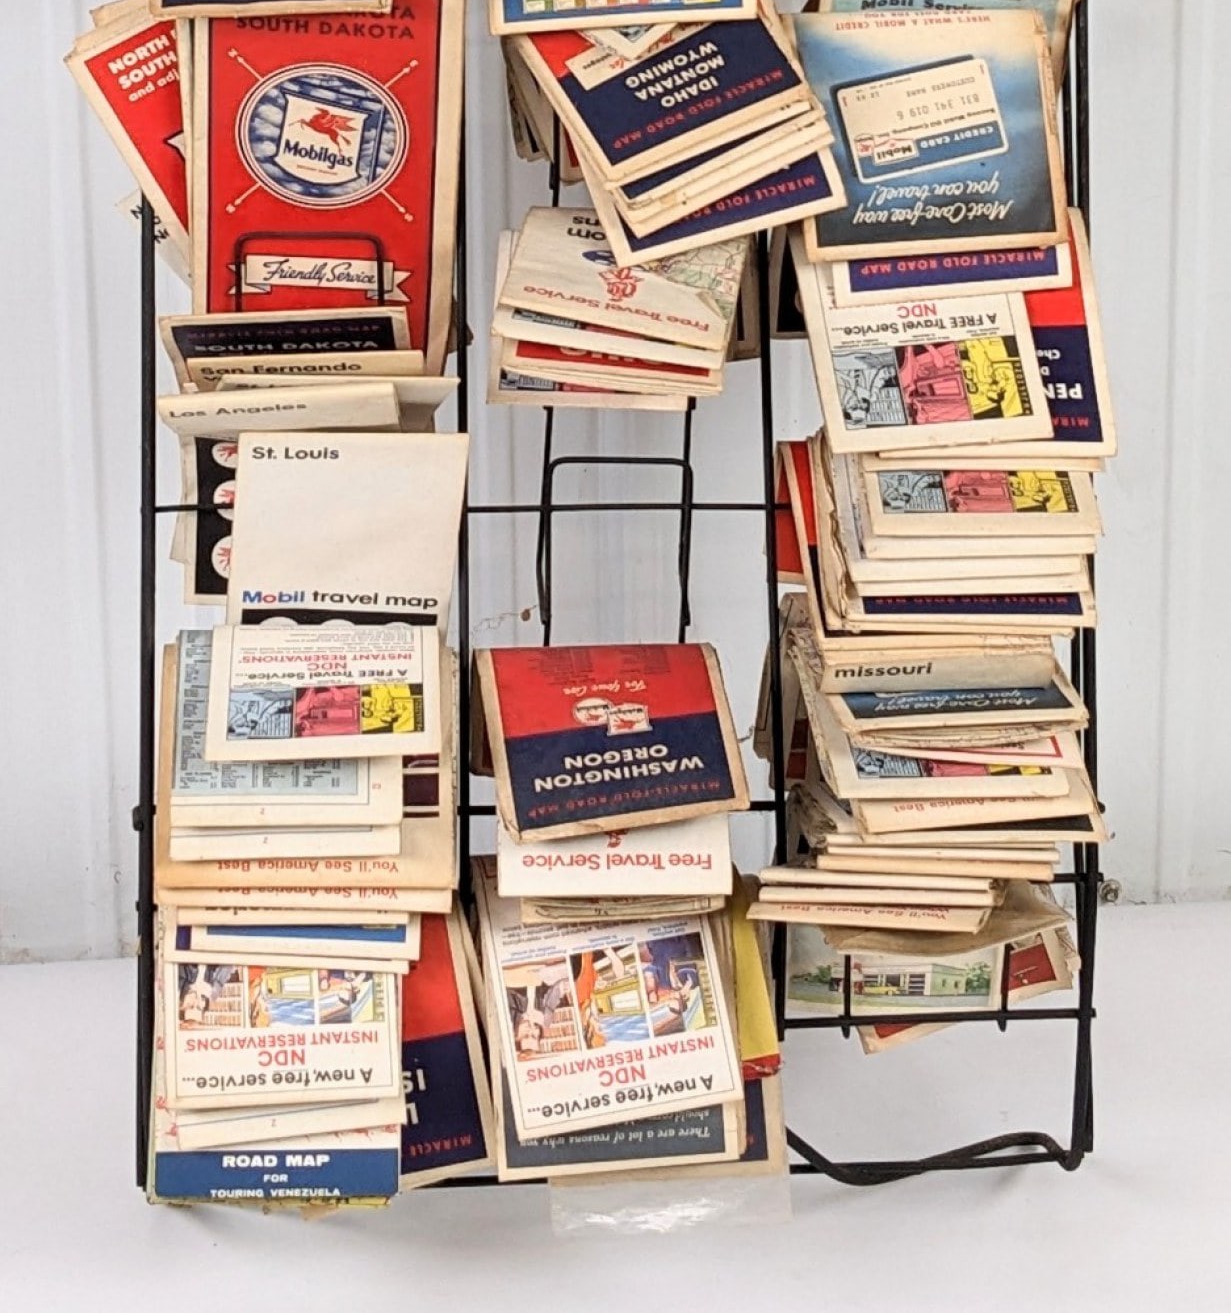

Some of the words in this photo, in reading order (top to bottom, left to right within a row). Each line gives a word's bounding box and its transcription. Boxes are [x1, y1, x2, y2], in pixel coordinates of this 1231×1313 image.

[236, 16, 309, 34] SOUTH
[319, 20, 415, 40] DAKOTA
[108, 35, 170, 74] NORTH
[118, 51, 178, 90] SOUTH
[625, 42, 718, 88] WYOMING
[635, 55, 725, 102] MONTANA
[129, 84, 155, 103] and
[661, 76, 719, 108] IDAHO
[920, 134, 950, 148] CARD
[952, 126, 994, 143] CREDIT
[283, 139, 353, 170] Mobilgas
[876, 146, 913, 161] Mobil
[932, 182, 965, 195] can
[968, 170, 1000, 195] you
[853, 204, 888, 225] way
[968, 199, 1014, 220] Most
[900, 259, 937, 271] ROAD
[944, 257, 978, 268] FOLD
[984, 252, 1045, 263] MIRACLE
[262, 261, 326, 286] Friendly
[326, 261, 377, 285] Service
[861, 263, 892, 276] MAP
[523, 286, 599, 309] Service
[605, 300, 661, 321] Travel
[898, 302, 938, 317] NDC
[667, 314, 710, 332] Free
[902, 315, 946, 332] Travel
[950, 313, 983, 328] FREE
[988, 312, 998, 324] A
[194, 343, 274, 351] SOUTH
[283, 339, 379, 351] DAKOTA
[200, 366, 245, 376] San
[253, 362, 362, 374] Fernando
[169, 409, 207, 418] Los
[216, 402, 307, 415] Angeles
[252, 446, 277, 460] St.
[284, 446, 339, 460] Louis
[242, 591, 305, 603] Mobil
[312, 591, 381, 606] travel
[386, 594, 438, 609] map
[835, 662, 932, 679] missouri
[564, 745, 668, 769] OREGON
[534, 755, 704, 792] WASHINGTON
[218, 860, 249, 872] Best
[258, 860, 318, 872] America
[326, 861, 352, 871] See
[360, 860, 399, 873] You'll
[522, 854, 600, 869] Service
[607, 854, 665, 869] Travel
[670, 854, 712, 869] Free
[311, 1031, 379, 1045] INSTANT
[649, 1037, 715, 1059] INSTANT
[258, 1050, 306, 1065] NDC
[273, 1070, 310, 1086] free
[314, 1069, 355, 1082] new,
[360, 1068, 373, 1081] A
[599, 1065, 647, 1086] NDC
[700, 1074, 714, 1089] A
[615, 1086, 654, 1104] free
[655, 1078, 696, 1097] new,
[569, 1133, 611, 1144] reasons
[613, 1130, 625, 1144] of
[626, 1129, 642, 1140] lot
[656, 1129, 675, 1137] are
[677, 1127, 710, 1137] There
[410, 1135, 472, 1156] MIRACLE
[222, 1154, 278, 1168] ROAD
[286, 1154, 330, 1167] MAP
[264, 1174, 288, 1183] FOR
[210, 1188, 264, 1198] TOURING
[270, 1188, 340, 1197] VENEZUELA
